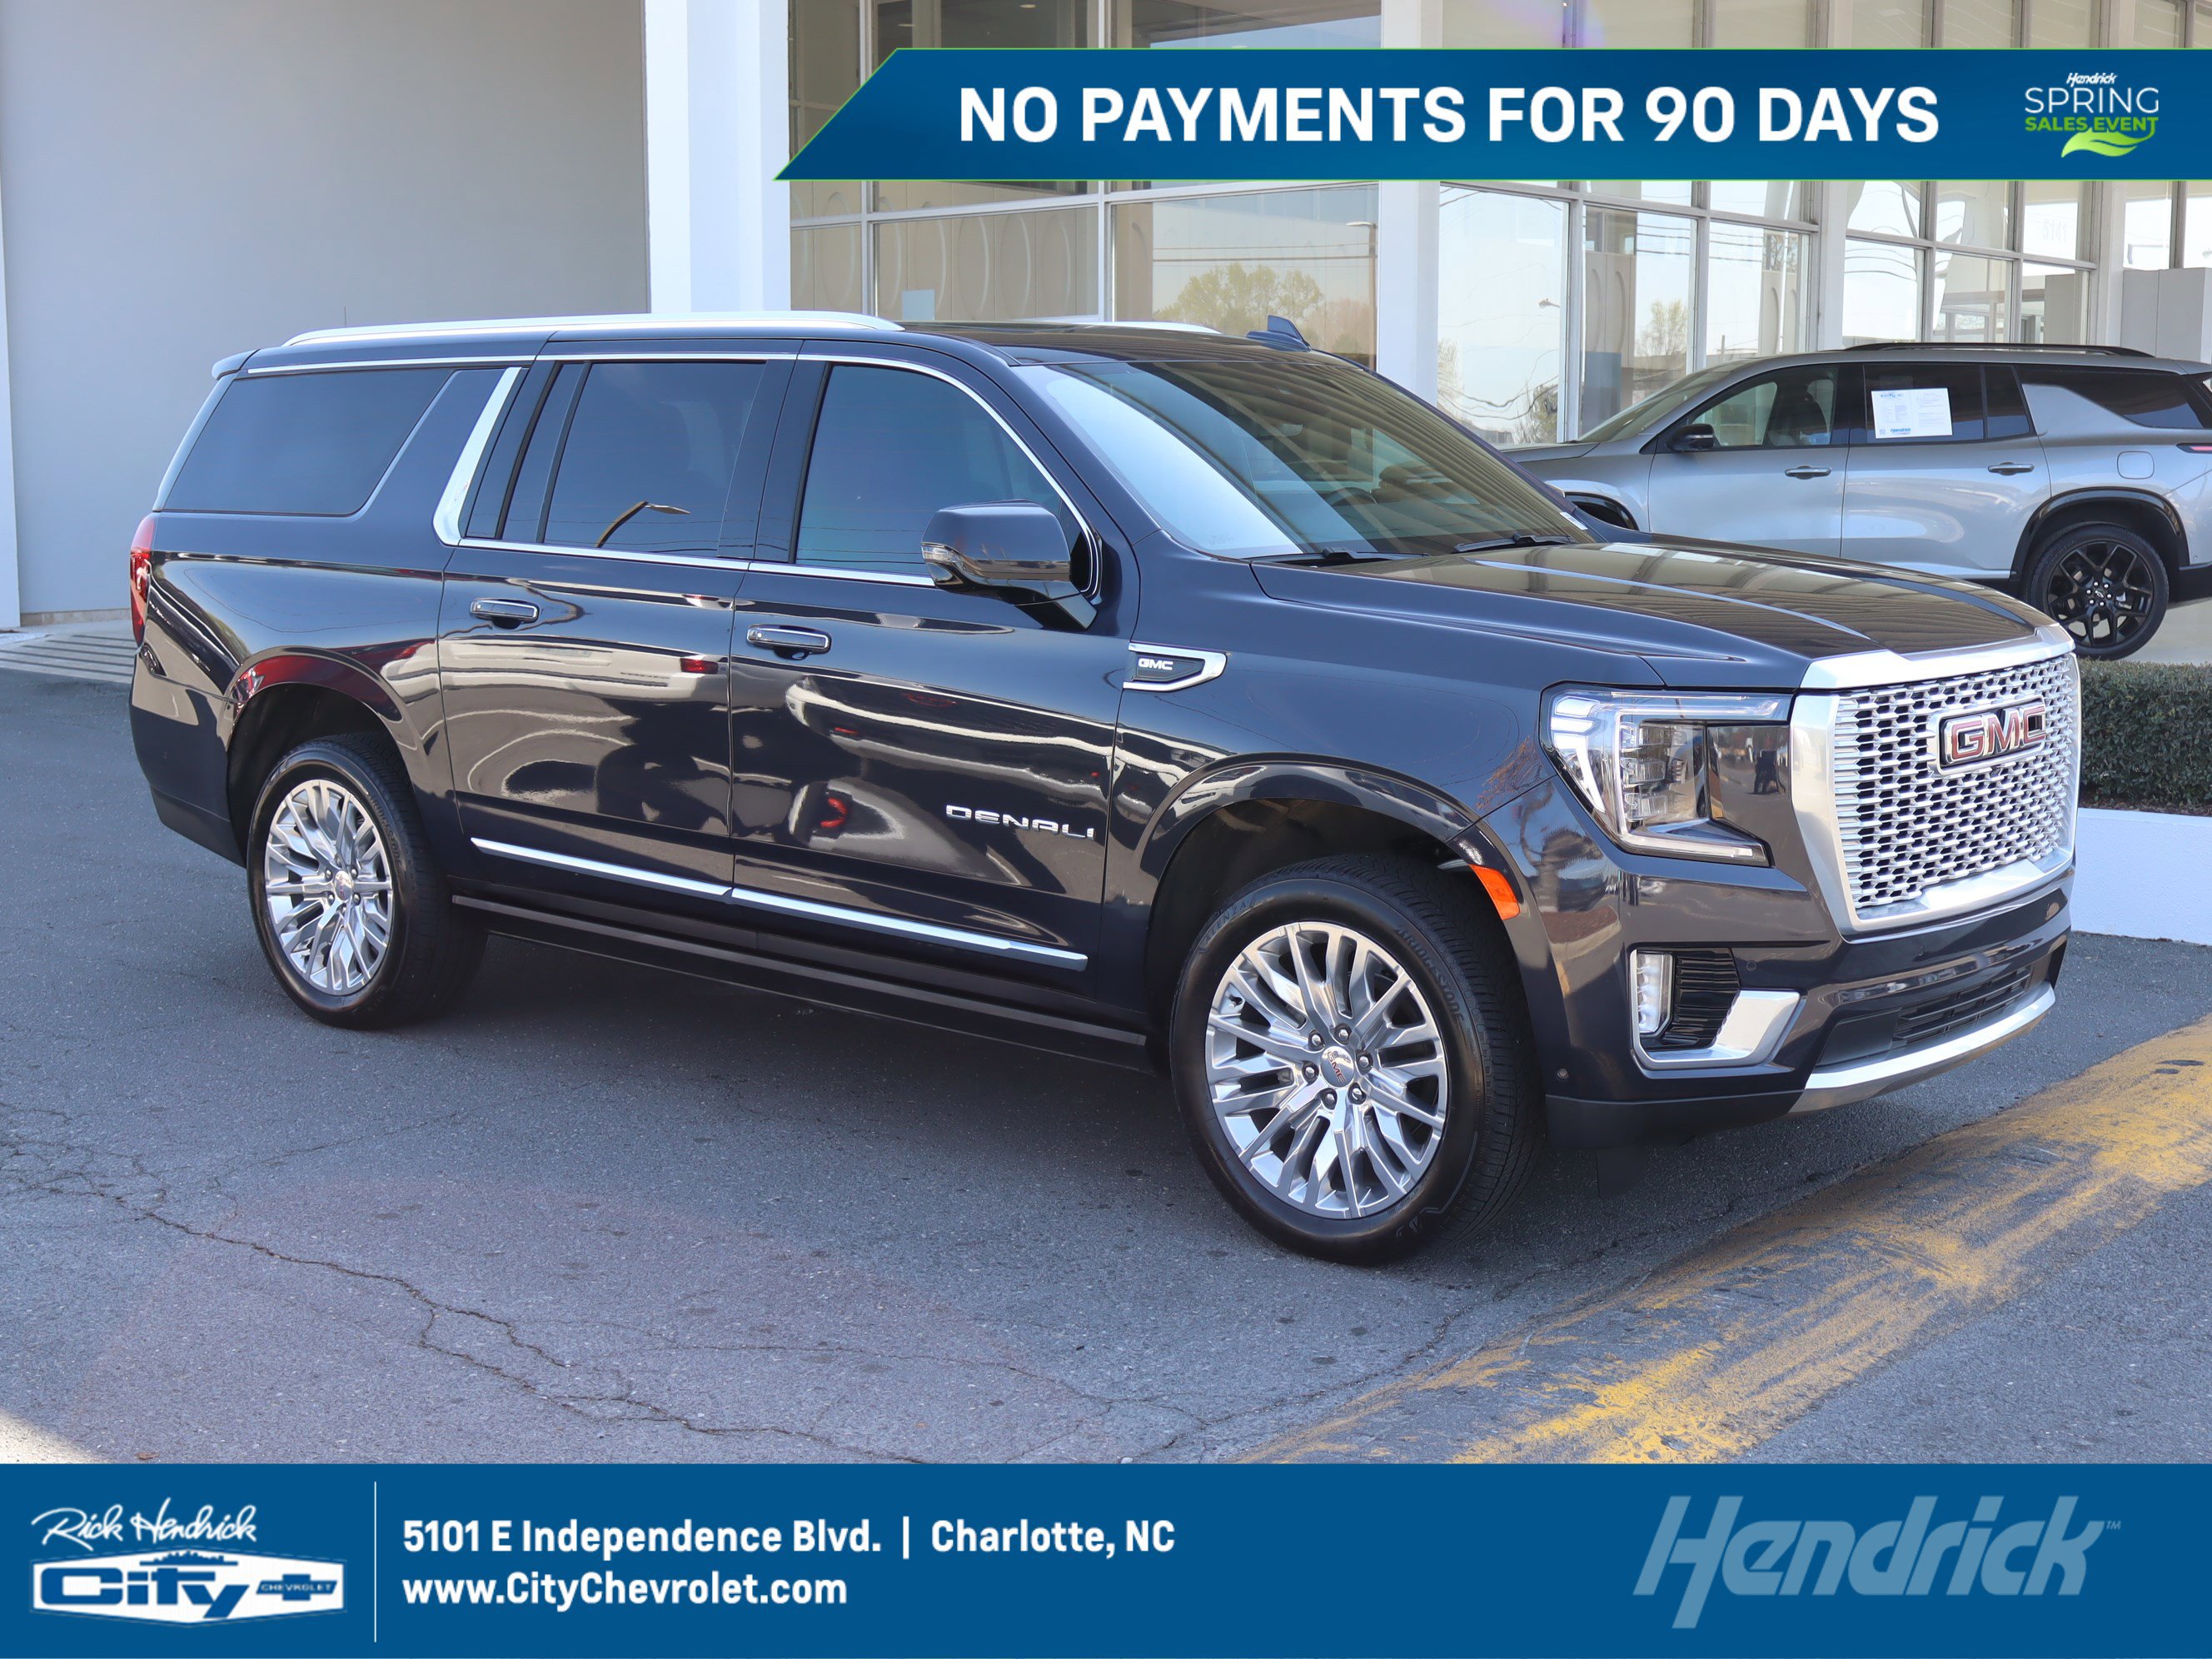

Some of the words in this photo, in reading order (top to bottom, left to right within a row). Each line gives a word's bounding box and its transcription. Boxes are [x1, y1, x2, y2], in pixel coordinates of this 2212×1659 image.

[1138, 657, 1173, 671] GMC
[1950, 706, 2046, 761] GMC
[946, 805, 1095, 840] DENALI
[1327, 1051, 1347, 1084] GMC
